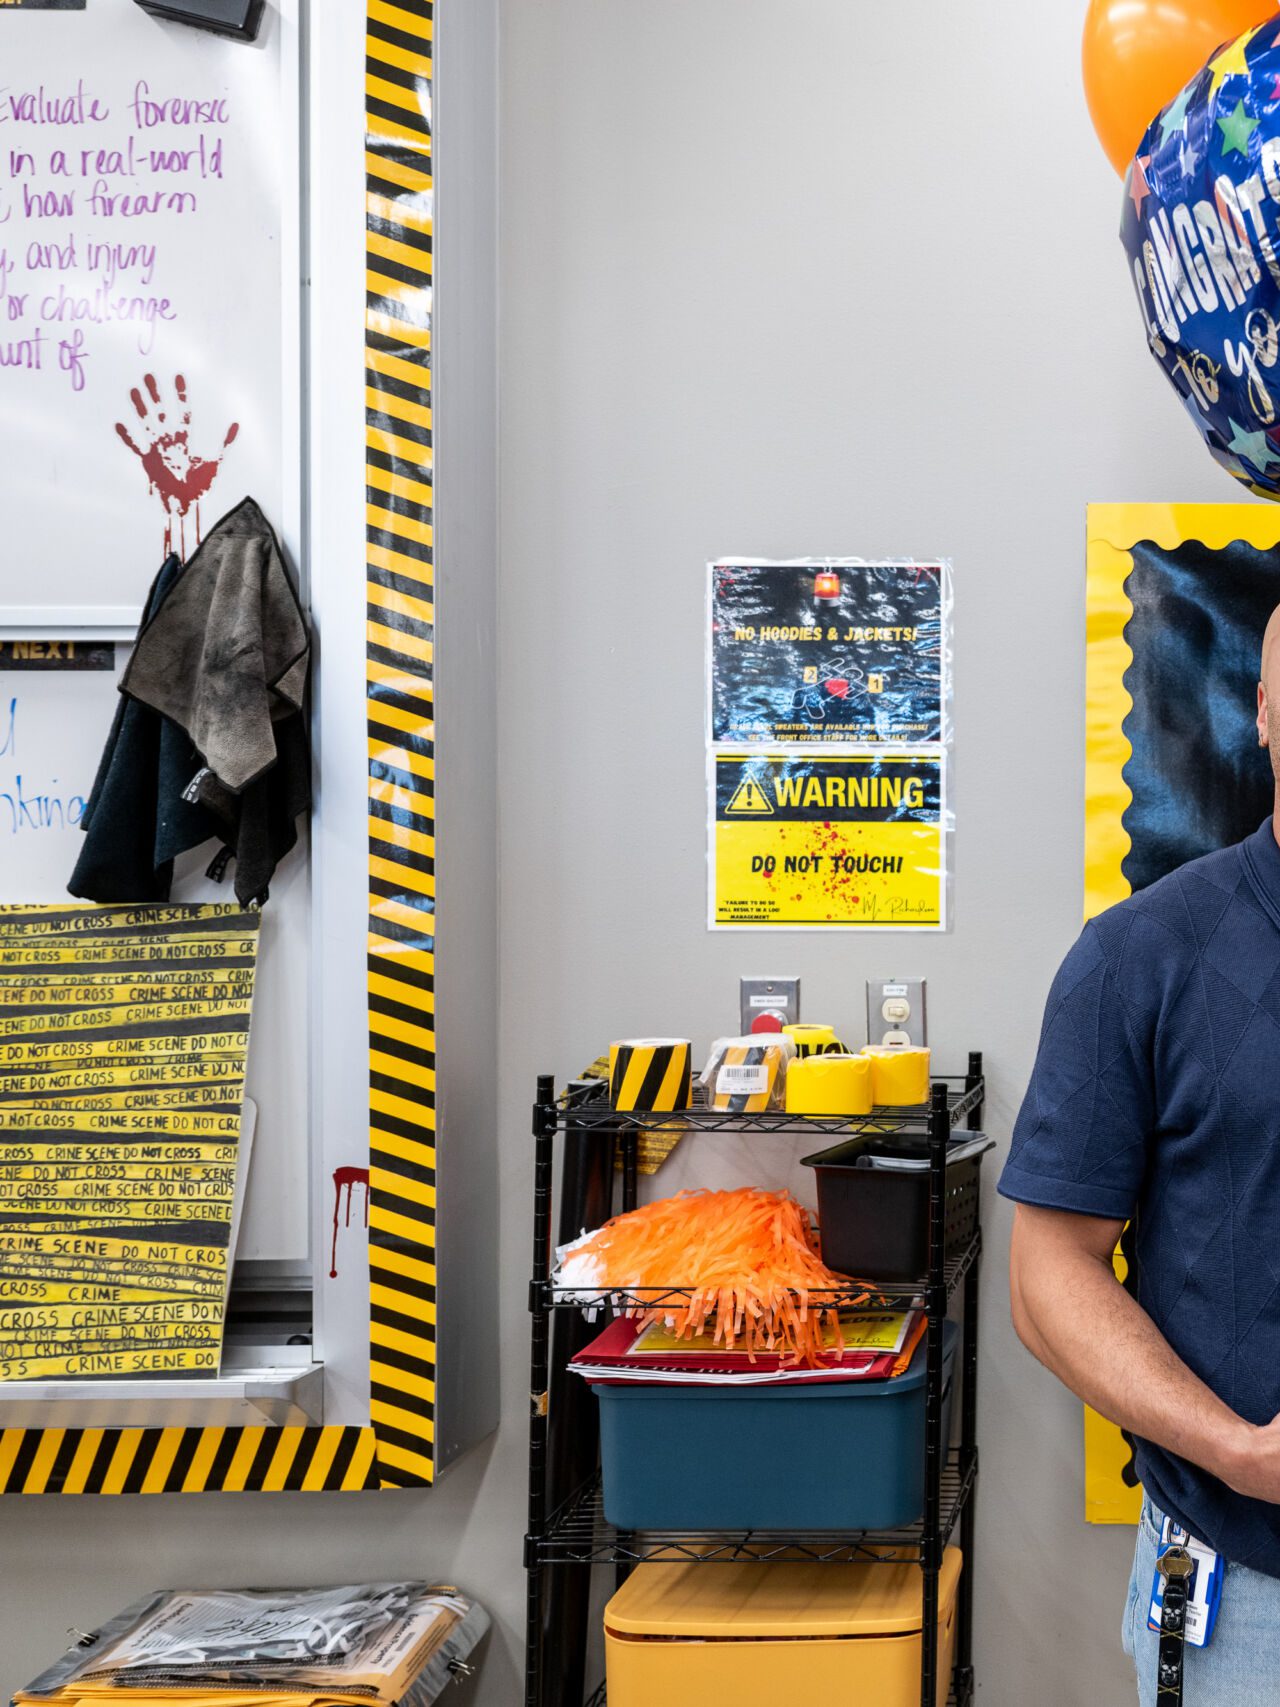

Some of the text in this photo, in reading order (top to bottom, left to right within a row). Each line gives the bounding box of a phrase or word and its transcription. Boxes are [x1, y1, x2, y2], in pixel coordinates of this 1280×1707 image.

[130, 80, 229, 128] forensic
[10, 135, 223, 178] in a real-world
[86, 179, 197, 217] firearm
[26, 233, 156, 284] and injury
[40, 283, 177, 355] challenge
[59, 328, 90, 390] of
[734, 626, 918, 641] NO HOODIES & JACKETS!
[12, 641, 76, 660] NEXT
[774, 776, 924, 808] WARNING
[751, 855, 904, 874] DO NOT TOUCH!
[74, 916, 113, 930] CROSS
[126, 908, 163, 925] CRIME
[214, 904, 232, 915] DO
[25, 951, 61, 962] CROSS
[74, 949, 108, 961] CRIME
[111, 947, 146, 960] SCENE
[149, 946, 163, 959] DO
[188, 943, 226, 958] CROSS
[30, 989, 46, 1002] DO
[50, 988, 72, 1002] NOT
[75, 987, 114, 1002] CROSS
[129, 987, 166, 1001] CRIME
[171, 985, 208, 999] SCENE
[213, 985, 228, 999] DO
[30, 1017, 45, 1030] DO
[48, 1014, 71, 1028] NOT
[73, 1011, 112, 1026] CROSS
[126, 1006, 163, 1021] CRIME
[166, 1003, 203, 1017] SCENE
[7, 1035, 233, 1060] DO NOT CROSS CRIME SCENE DO NOT
[30, 1063, 228, 1090] DO NOT CROSS CRIME SCENE DO
[75, 1086, 242, 1109] CROSS CRIME SCENE DO NOT
[9, 1113, 214, 1130] NOT CROSS CRIME SCENE DO NOT
[123, 1145, 201, 1160] DO NOT CROSS
[33, 1165, 235, 1181] DO NOT CROSS SCENE
[18, 1182, 201, 1197] CROSS CRIME SCENE DO NOT
[92, 1200, 223, 1220] CROSS SCENE
[53, 1239, 178, 1260] SCENE DO NOT
[0, 1282, 47, 1298] CROSS
[68, 1286, 121, 1301] CRIME
[1, 1303, 209, 1329] CROSS CRIME SCENE DO
[122, 1325, 137, 1339] DO
[144, 1325, 168, 1339] NOT
[174, 1325, 212, 1340] CROSS
[65, 1353, 214, 1374] CRIME SCENE DO
